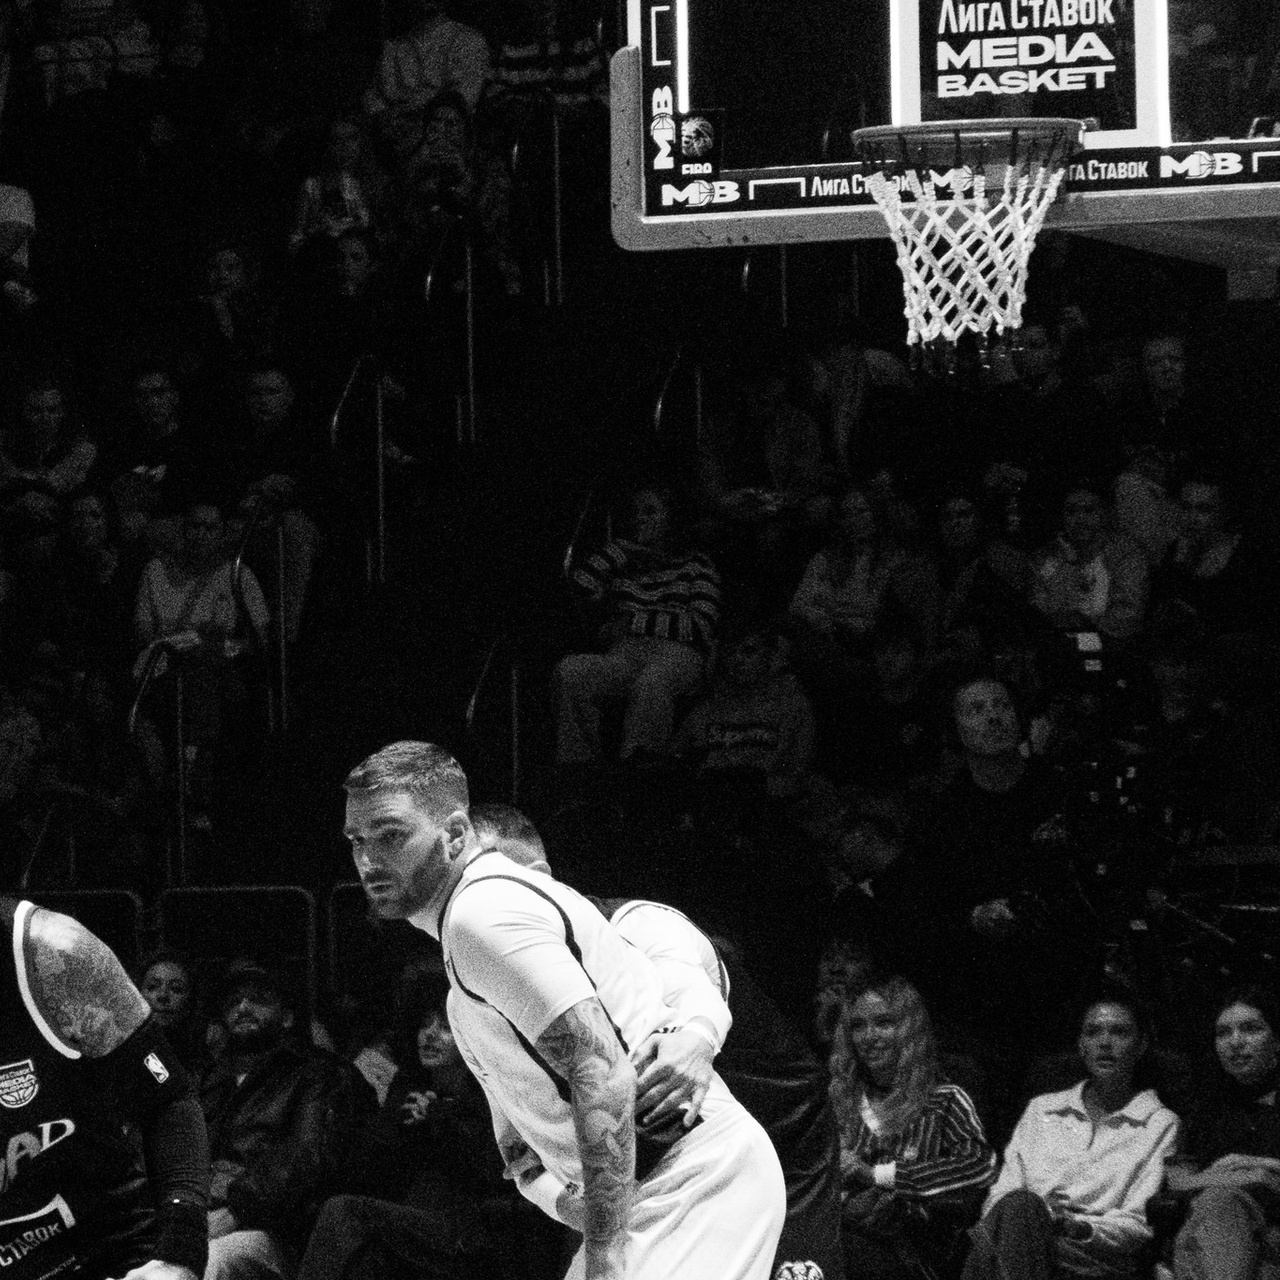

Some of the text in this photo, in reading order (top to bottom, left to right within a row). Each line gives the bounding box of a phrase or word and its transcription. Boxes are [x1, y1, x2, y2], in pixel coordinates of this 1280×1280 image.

[936, 31, 1116, 71] MEDIA
[937, 65, 1117, 98] BASKET
[1087, 159, 1149, 181] СТАВОК
[811, 176, 850, 197] ЛИГА
